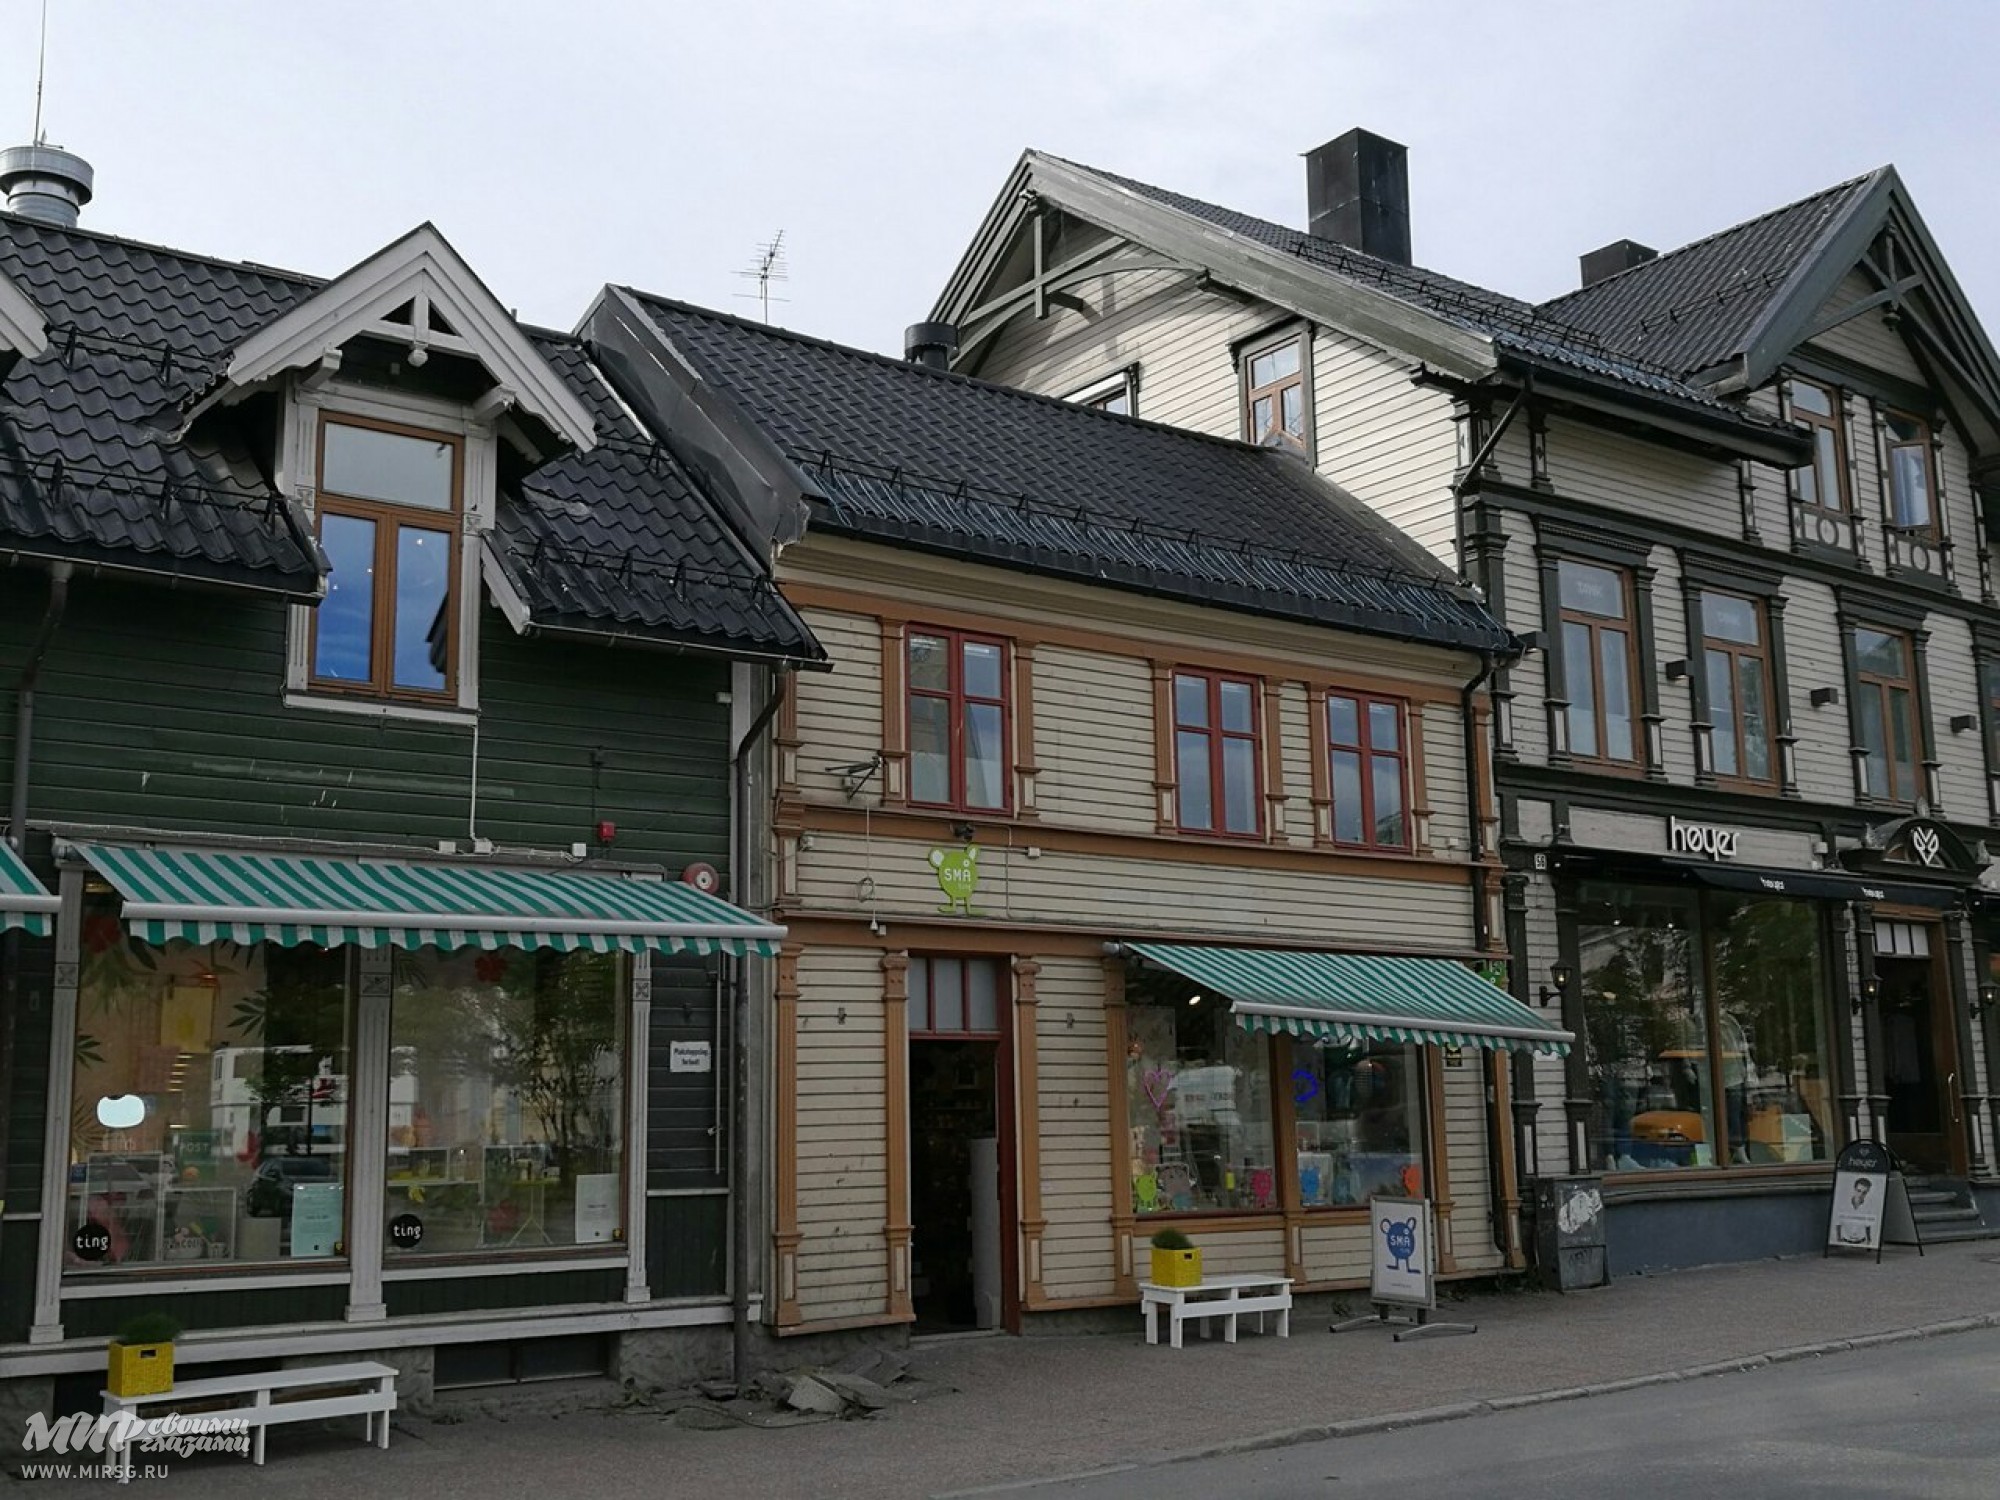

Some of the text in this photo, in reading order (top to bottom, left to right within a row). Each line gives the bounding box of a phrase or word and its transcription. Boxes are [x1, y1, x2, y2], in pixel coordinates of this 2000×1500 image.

[1670, 815, 1740, 862] høyer
[393, 1222, 420, 1239] ting
[76, 1233, 108, 1250] ting
